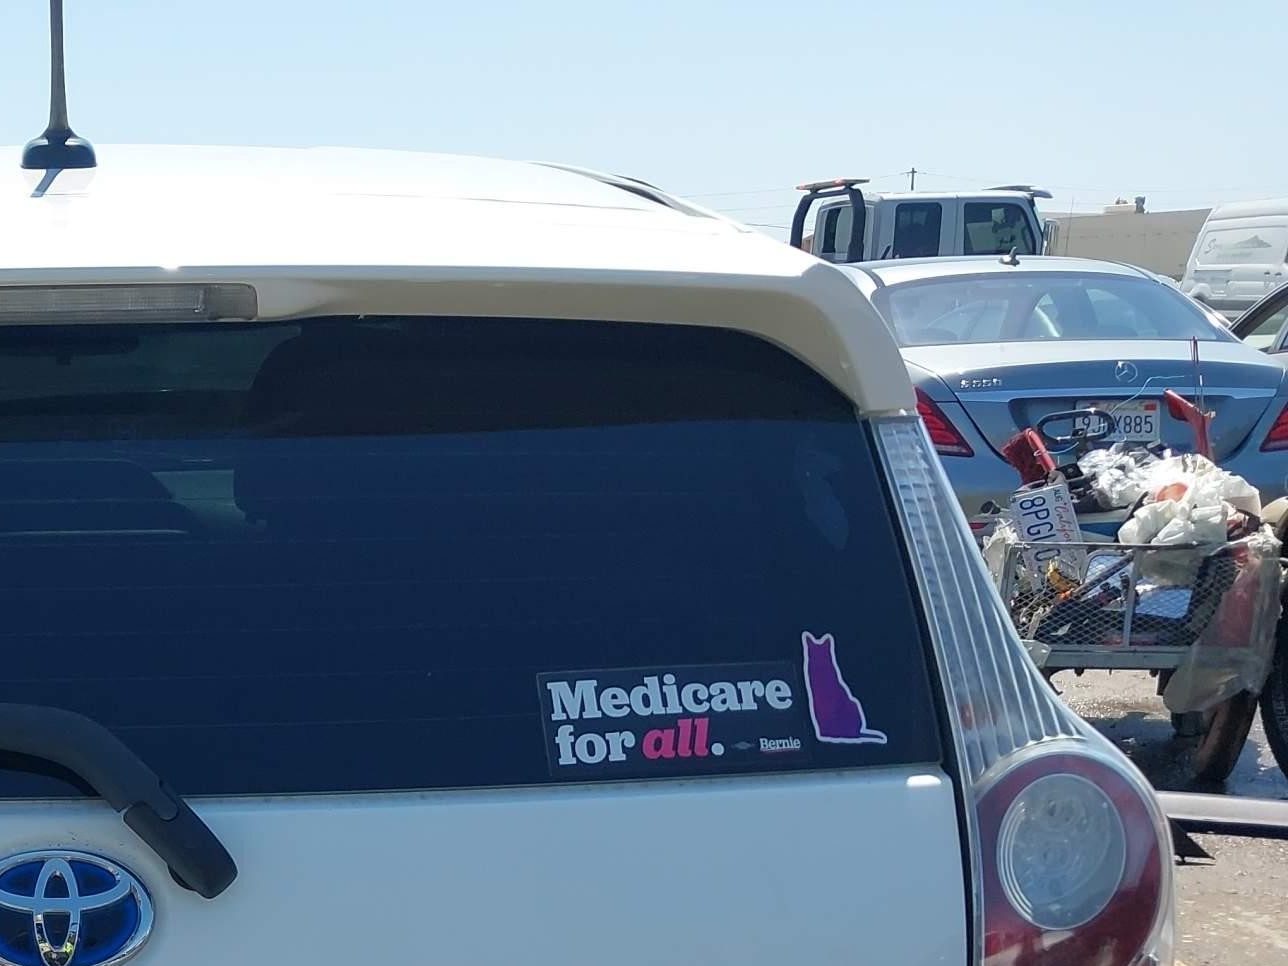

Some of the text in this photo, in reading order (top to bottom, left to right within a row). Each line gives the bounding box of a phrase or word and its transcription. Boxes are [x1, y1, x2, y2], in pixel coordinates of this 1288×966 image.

[1081, 415, 1154, 434] 9JX885
[547, 673, 792, 721] Medicare
[555, 718, 724, 765] for all.
[759, 736, 801, 750] Bernie
